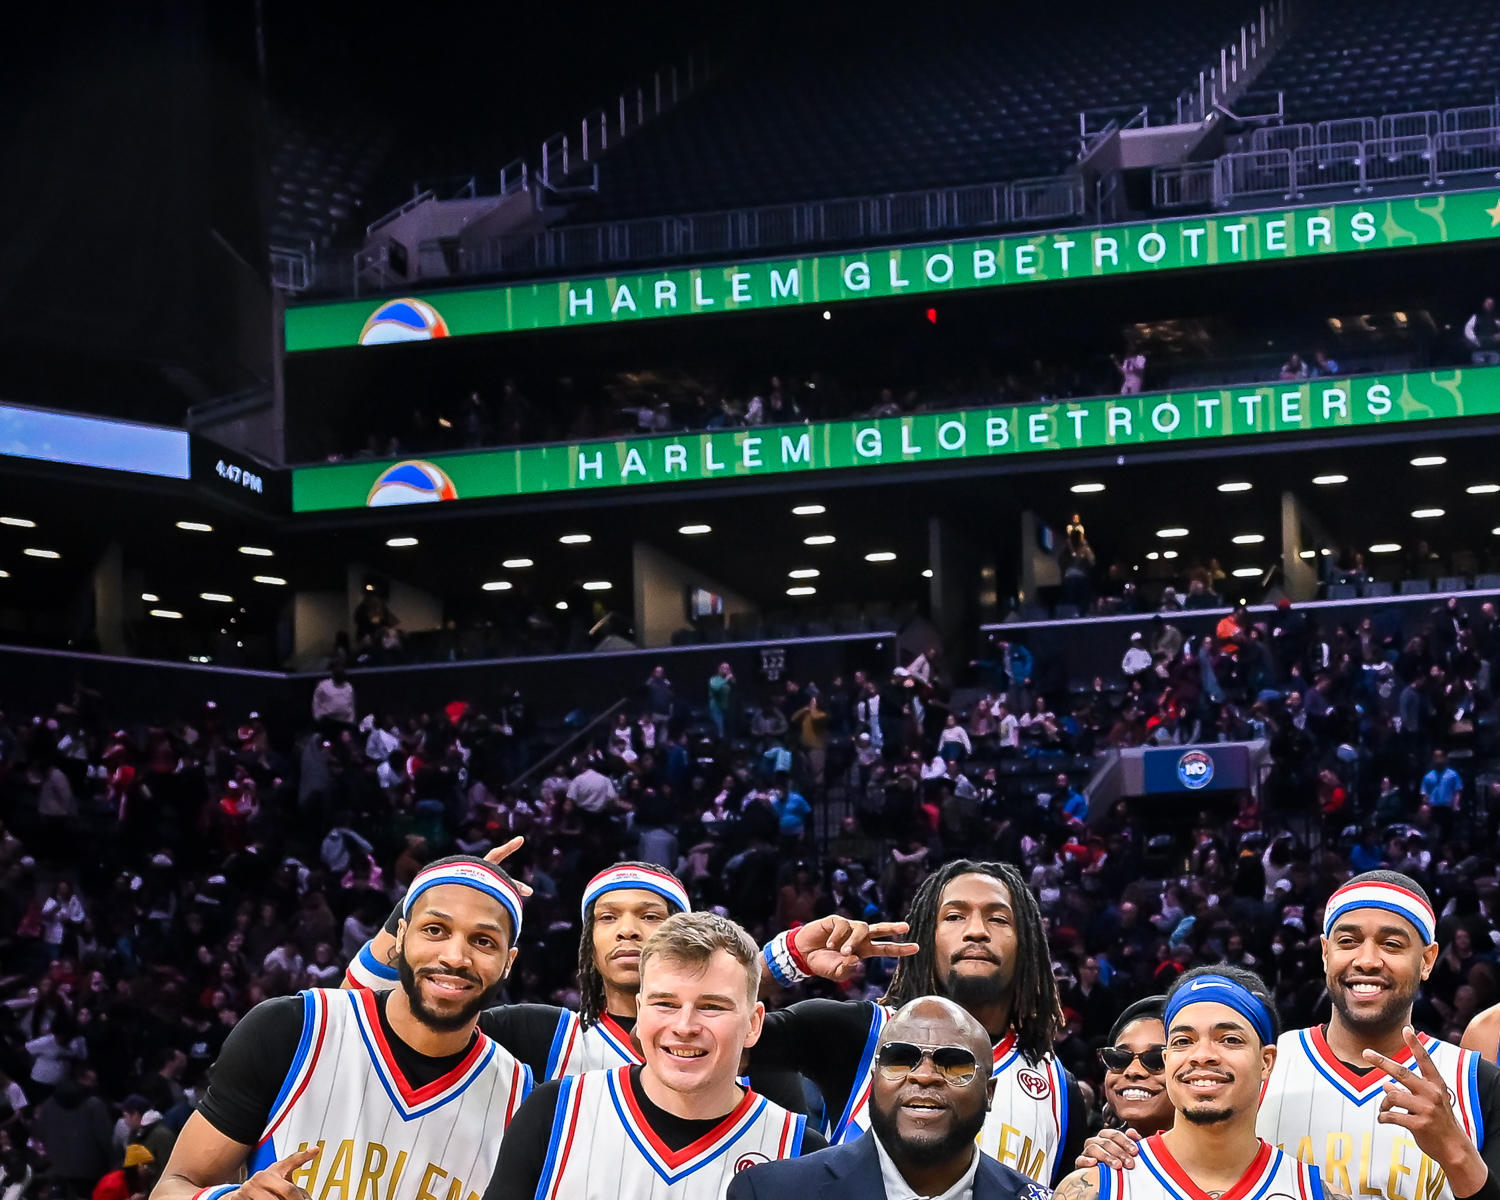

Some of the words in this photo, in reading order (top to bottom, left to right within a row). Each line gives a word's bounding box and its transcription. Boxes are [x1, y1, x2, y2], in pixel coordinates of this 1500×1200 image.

[568, 269, 801, 317] HARLEM
[843, 212, 1377, 290] GLOBETROTTERS
[578, 433, 812, 480] HARLEM
[854, 384, 1393, 457] GLOBETROTTERS
[243, 471, 263, 494] PM
